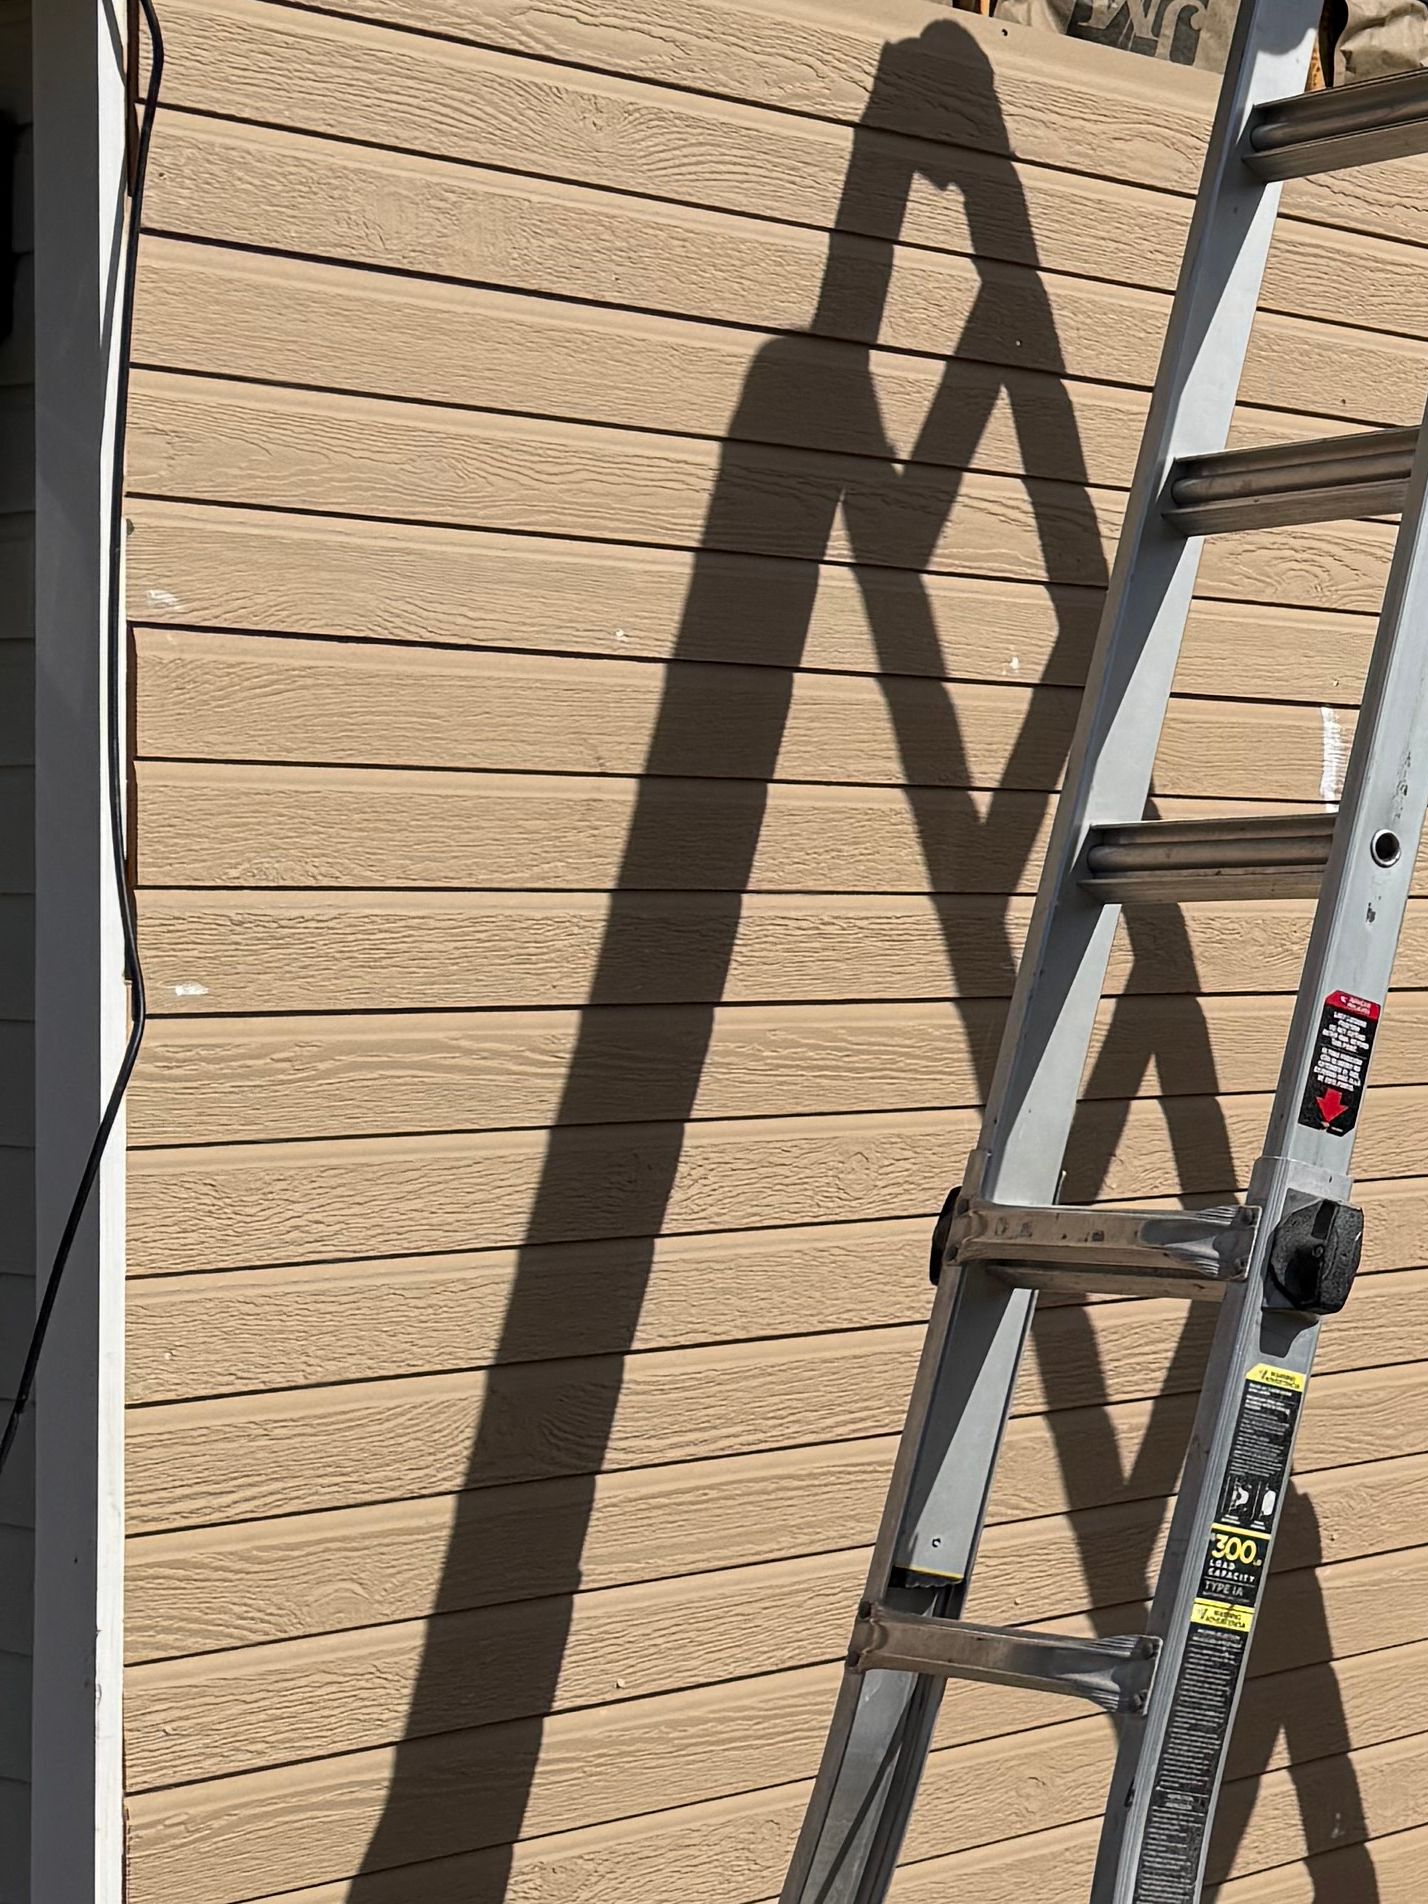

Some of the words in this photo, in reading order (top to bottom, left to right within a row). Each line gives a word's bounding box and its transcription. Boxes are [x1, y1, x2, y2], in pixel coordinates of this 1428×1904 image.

[1211, 1533, 1257, 1564] 300
[1209, 1558, 1236, 1571] LOAD
[1207, 1567, 1256, 1583] CAPACITY
[1204, 1581, 1231, 1596] TYPE
